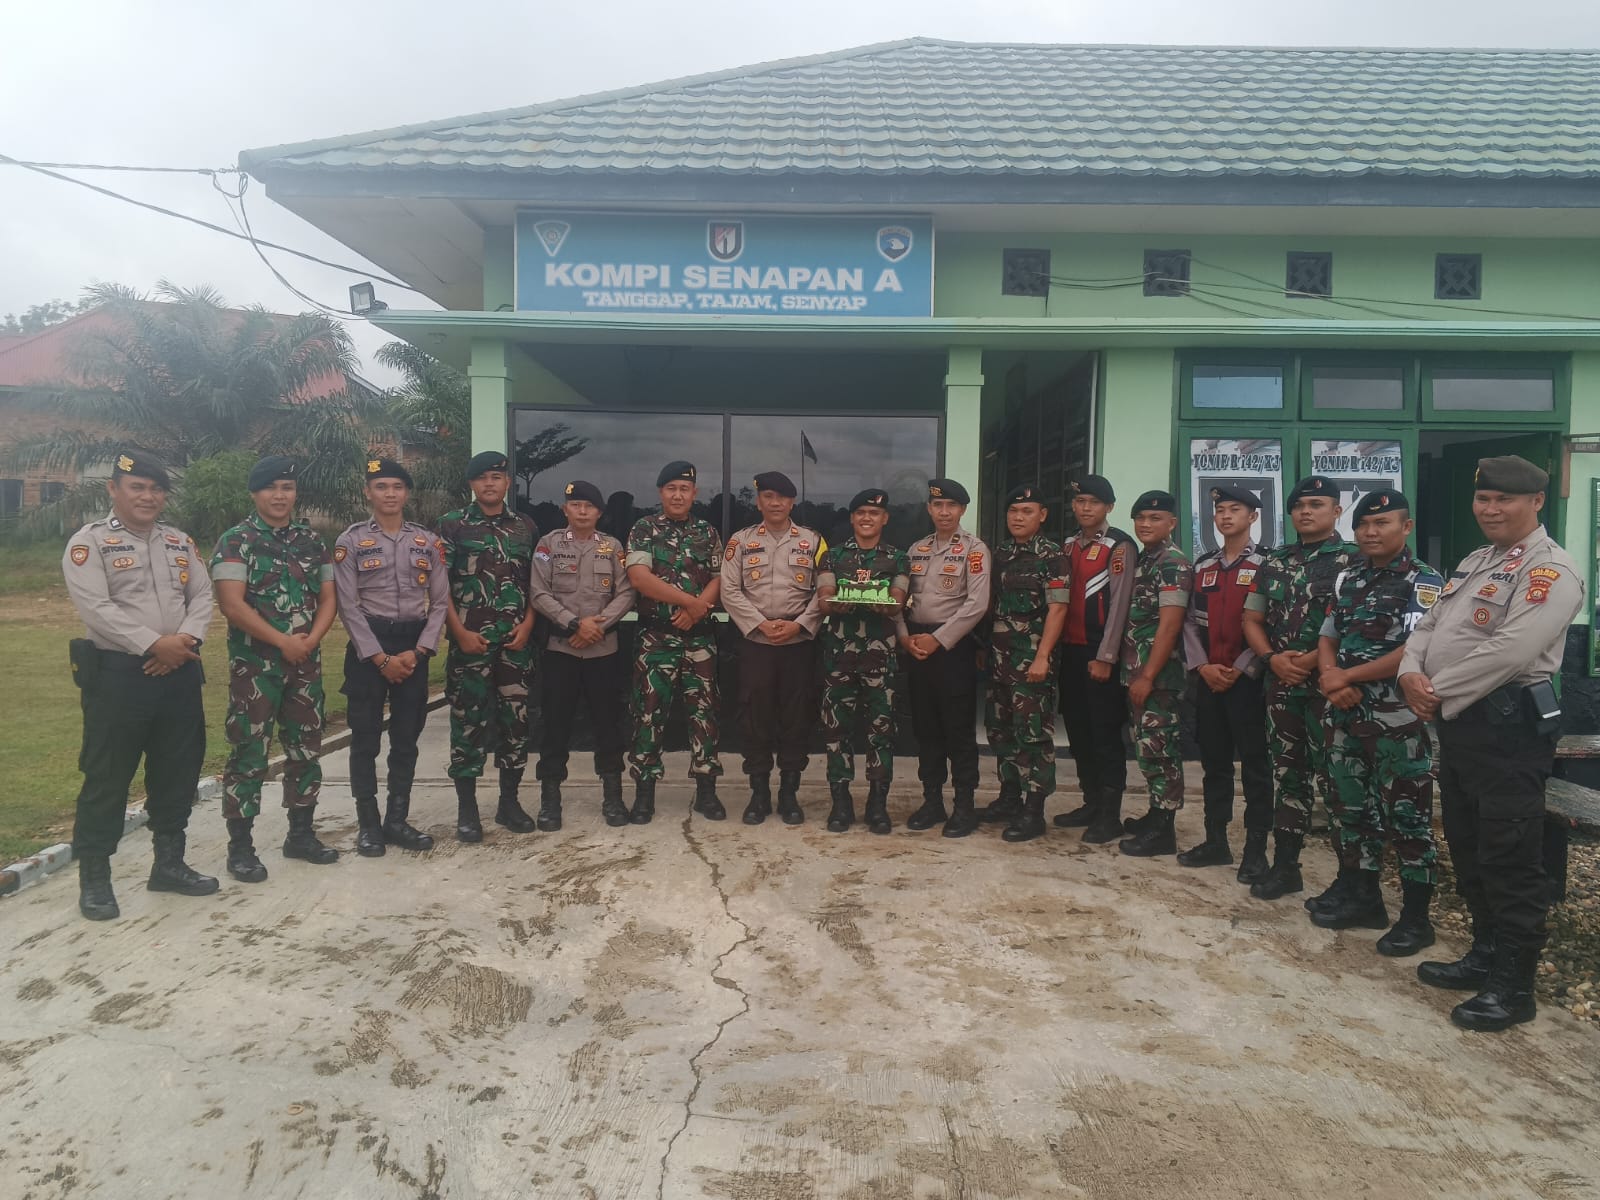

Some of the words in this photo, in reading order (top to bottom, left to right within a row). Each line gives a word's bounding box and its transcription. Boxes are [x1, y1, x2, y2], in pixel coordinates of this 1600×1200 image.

[545, 263, 671, 288] KOMPI
[683, 265, 863, 291] SENAPAN
[874, 268, 903, 292] A
[582, 291, 693, 309] TANGGAP,
[698, 293, 777, 311] TAJAM,
[781, 295, 867, 311] SENYAP
[1193, 454, 1229, 471] YONIF
[1313, 455, 1349, 472] YONIF
[165, 544, 189, 553] POLRI
[357, 547, 383, 557] ANDRE
[791, 548, 814, 558] POLRI
[1488, 572, 1516, 584] POLRI
